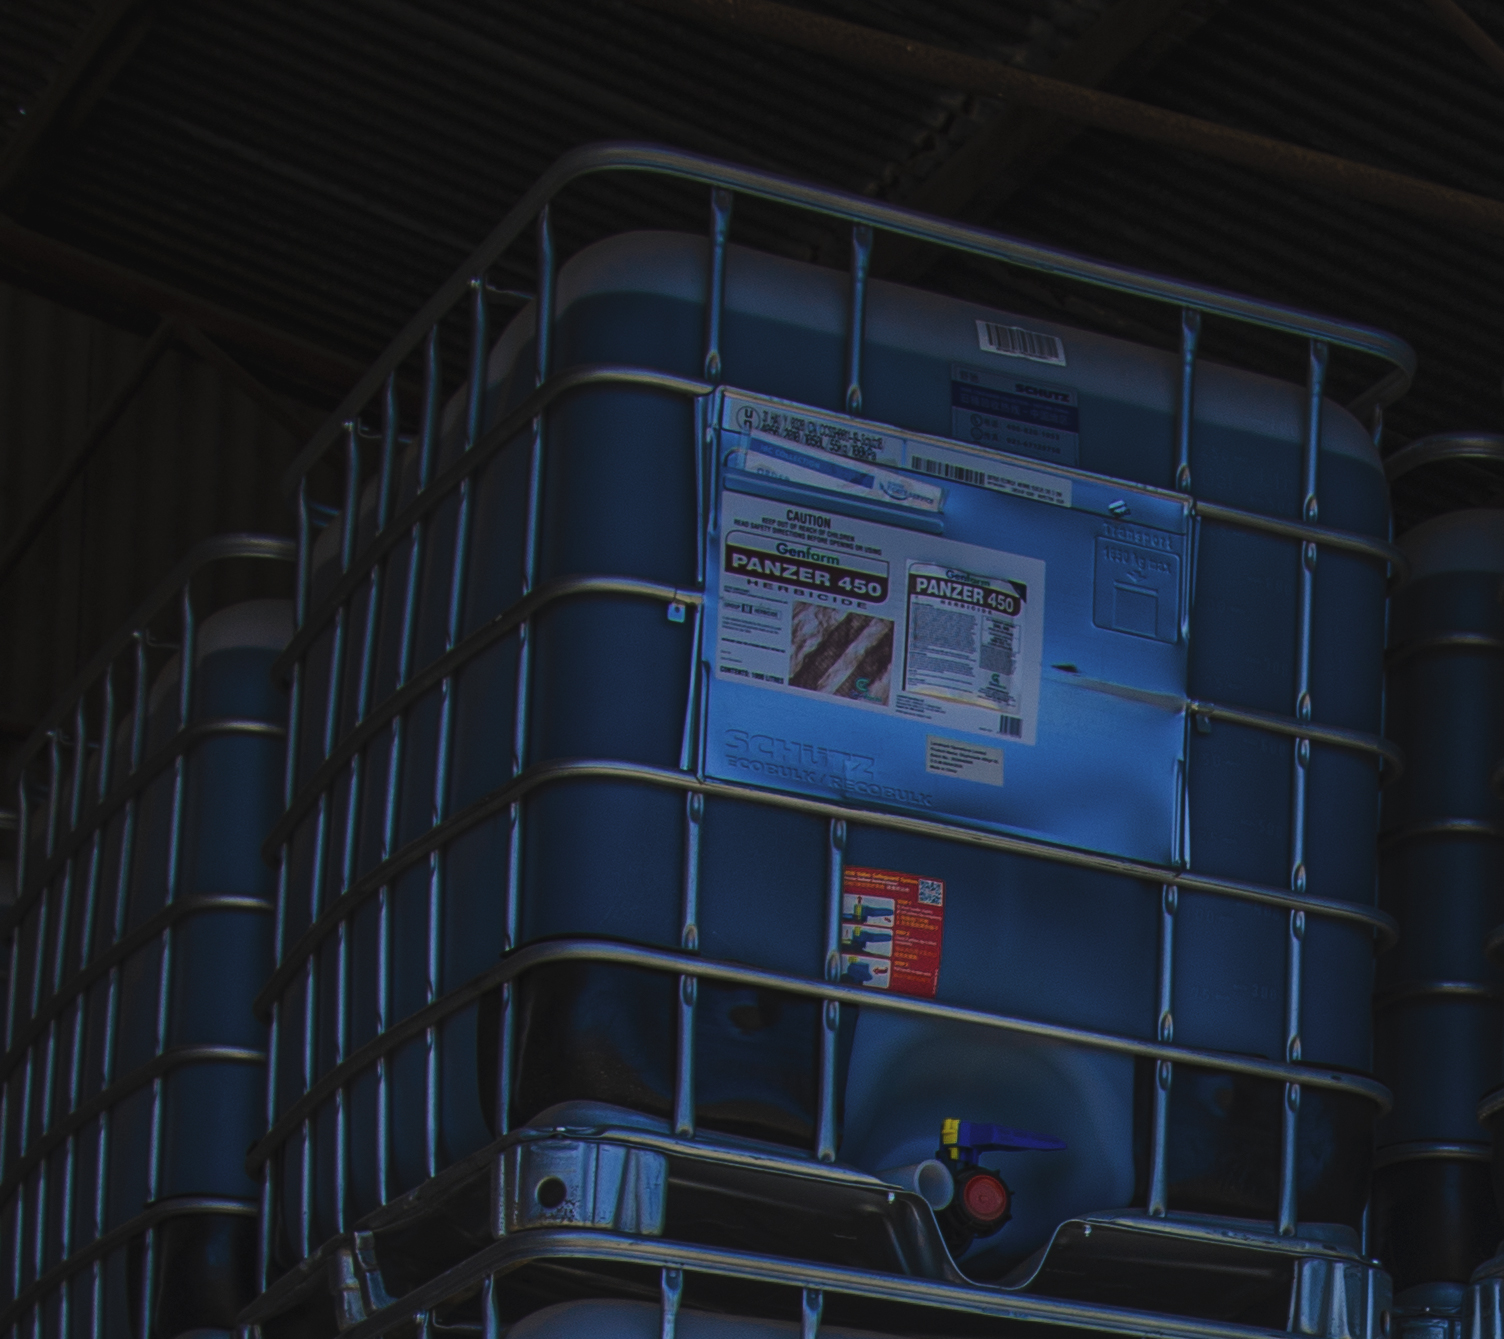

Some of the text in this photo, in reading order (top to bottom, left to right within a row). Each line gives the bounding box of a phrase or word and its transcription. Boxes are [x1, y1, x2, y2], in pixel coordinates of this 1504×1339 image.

[1015, 383, 1070, 402] SCHUTZ
[786, 510, 831, 529] CAUTION
[776, 542, 840, 566] Genfarm
[732, 552, 882, 598] PANZER 450
[747, 579, 868, 610] HERBICIDE
[916, 577, 1014, 614] PANZER 450
